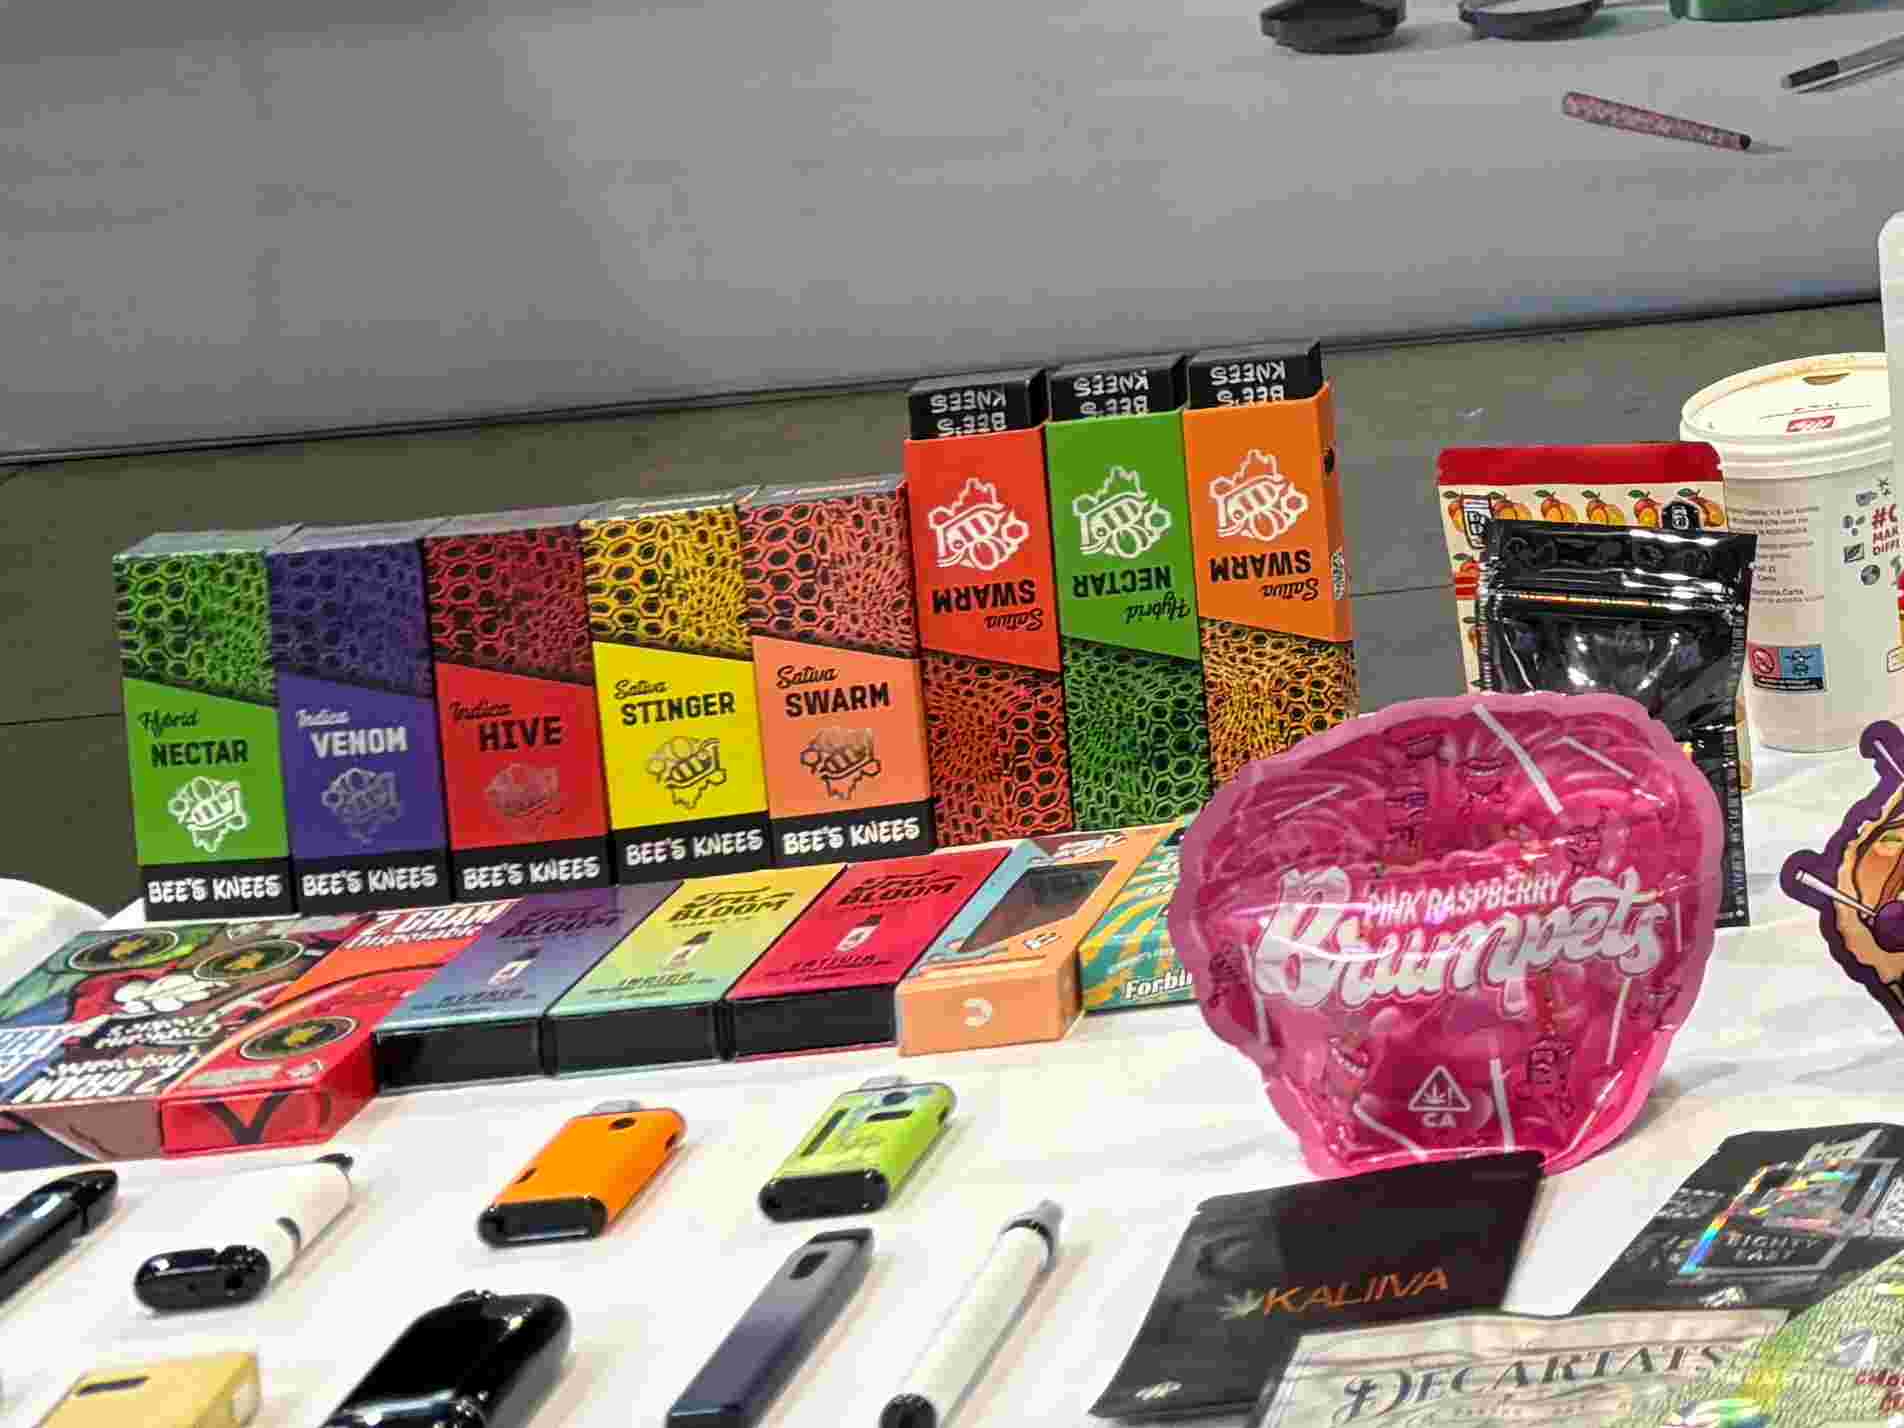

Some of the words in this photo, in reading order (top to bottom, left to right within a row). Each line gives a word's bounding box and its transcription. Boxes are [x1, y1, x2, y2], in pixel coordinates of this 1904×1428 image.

[1071, 567, 1171, 600] NECTAR
[1209, 551, 1312, 584] SWARM
[931, 578, 1037, 616] SWARM
[1261, 577, 1320, 601] Sativa
[984, 607, 1045, 632] Sativa
[1126, 595, 1192, 625] Hybrid
[776, 662, 838, 690] Sativa
[620, 691, 736, 727] STINGER
[784, 682, 891, 719] SWARM
[310, 727, 409, 759] VENOM
[478, 715, 564, 751] HIVE
[151, 737, 250, 768] NECTAR
[625, 836, 689, 867] BEE'S
[692, 828, 765, 857] KNEES
[783, 825, 844, 856] BEE'S
[849, 819, 921, 847] KNEES
[148, 875, 206, 907] BEE'S
[213, 873, 281, 903] KNEES
[302, 869, 361, 899] BEE'S
[367, 864, 438, 892] KNEES
[463, 861, 525, 891] BEE'S
[529, 856, 601, 884] KNEES
[1427, 871, 1568, 918] RASPBERRY
[394, 900, 513, 933] GRAM
[1422, 1110, 1457, 1129] CA
